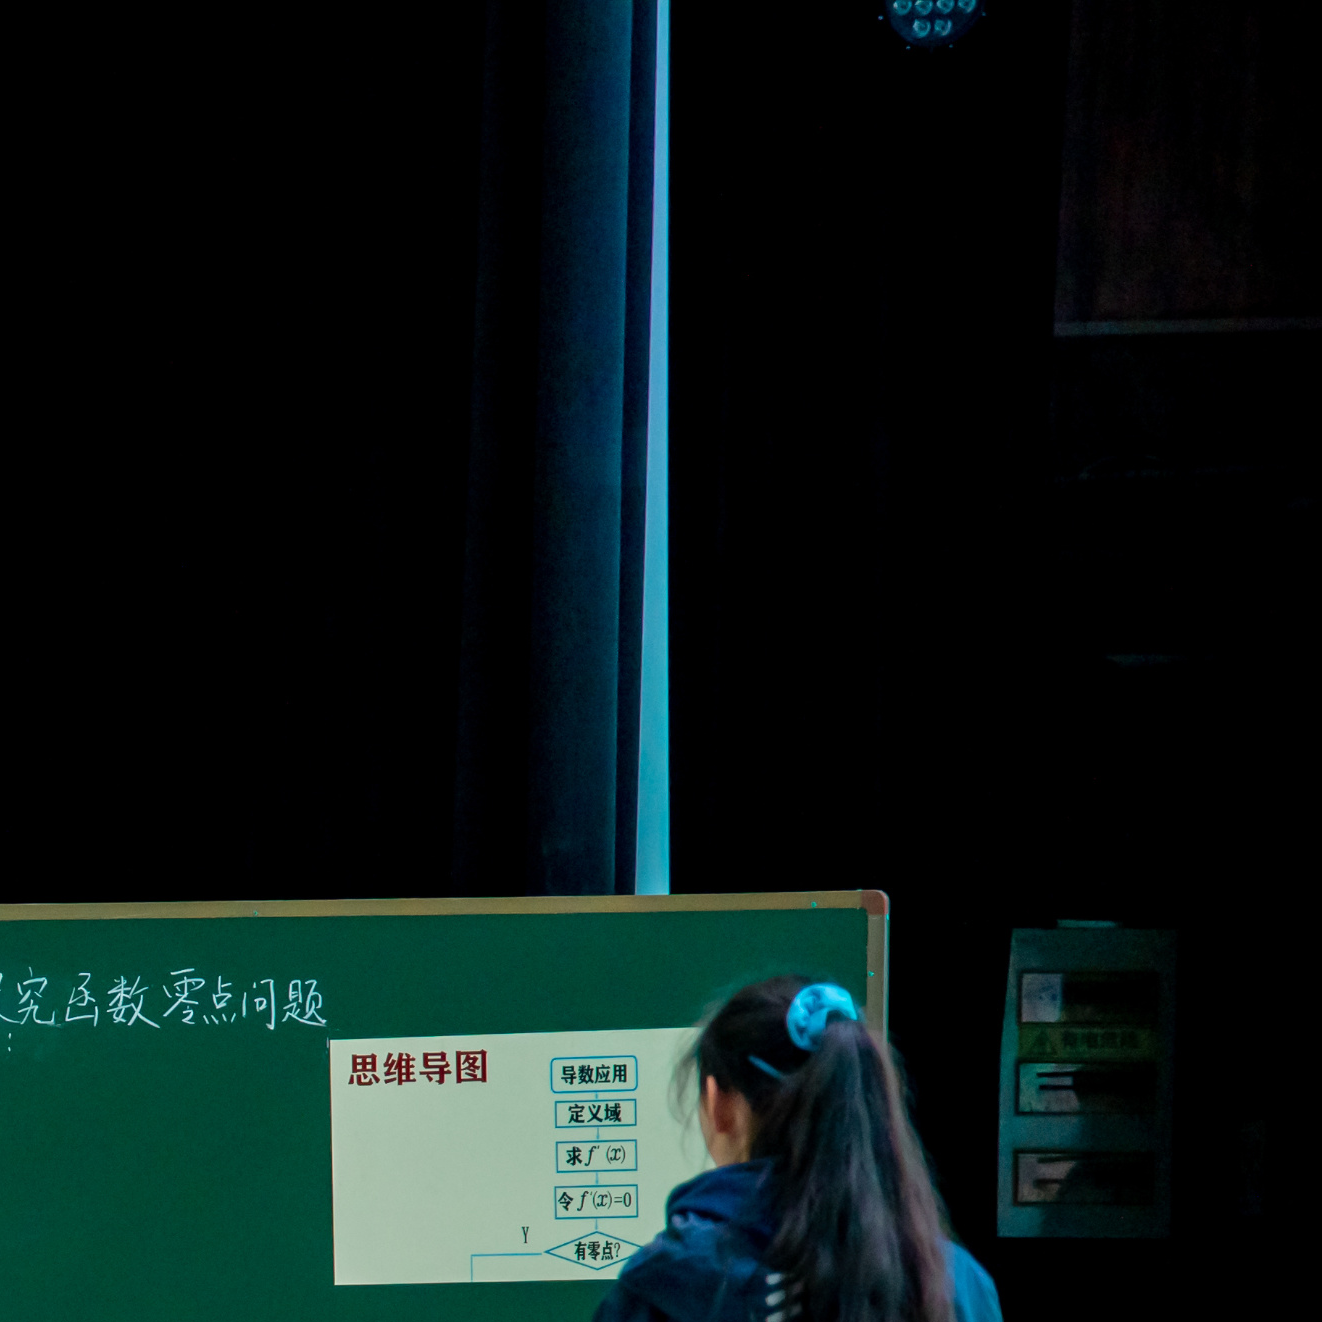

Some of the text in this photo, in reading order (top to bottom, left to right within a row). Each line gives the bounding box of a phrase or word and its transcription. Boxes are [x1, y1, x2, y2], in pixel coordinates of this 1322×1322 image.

[348, 1048, 488, 1087] 思维导图
[560, 1063, 628, 1085] 导数应用
[567, 1102, 622, 1124] 定义域
[521, 1226, 530, 1244] Y
